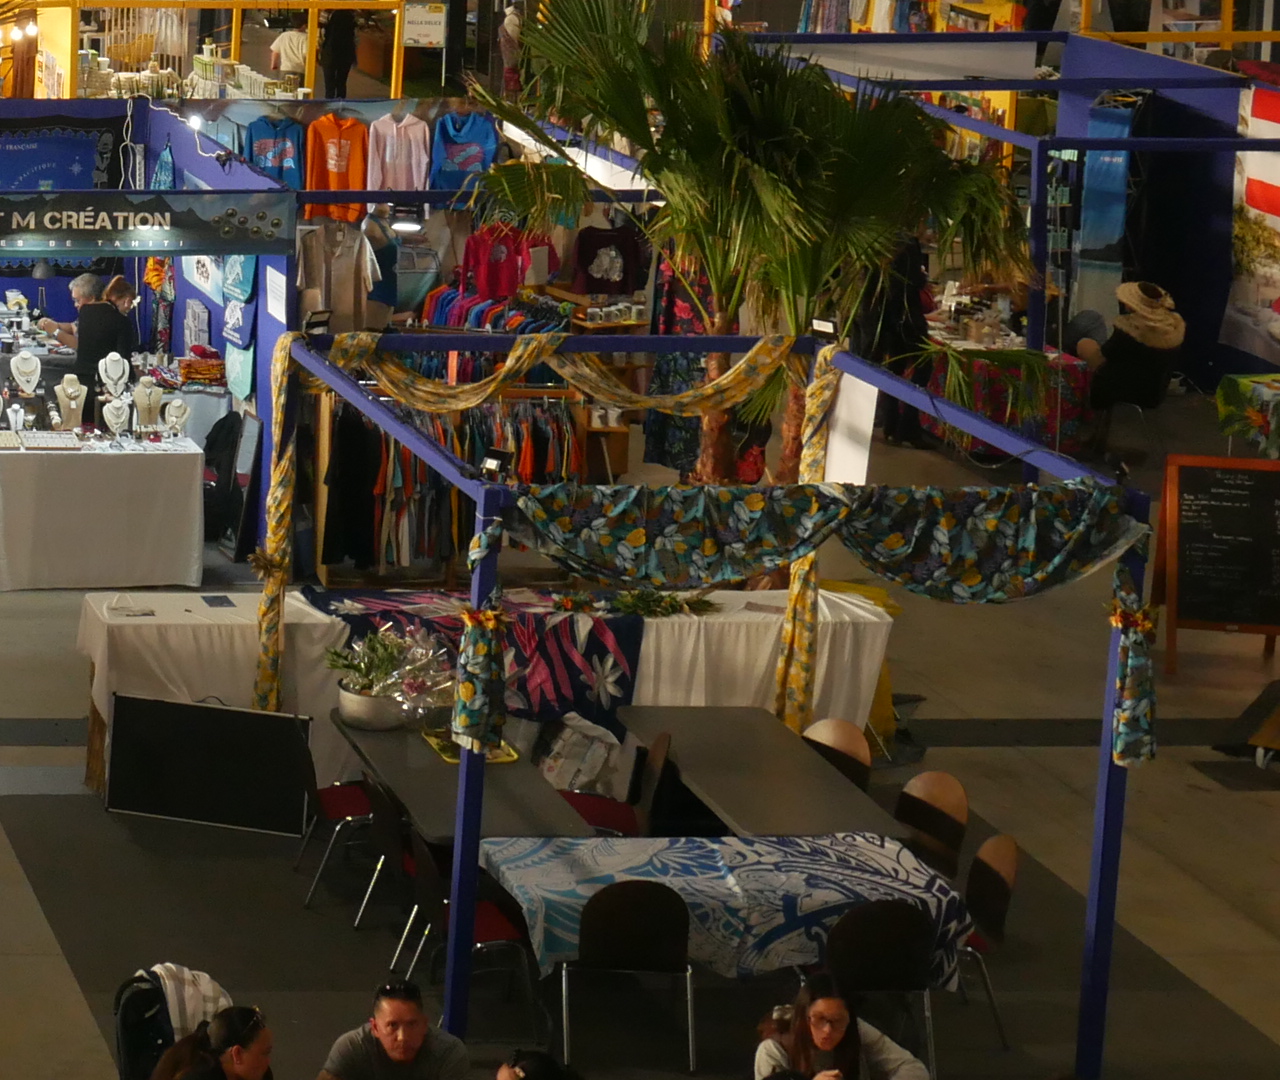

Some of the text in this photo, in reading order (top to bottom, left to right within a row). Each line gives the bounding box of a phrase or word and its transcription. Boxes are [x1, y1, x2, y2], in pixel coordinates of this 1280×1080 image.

[12, 212, 36, 230] M
[43, 206, 172, 231] CRÉATION
[49, 239, 74, 248] DE
[98, 239, 184, 248] TAHITI
